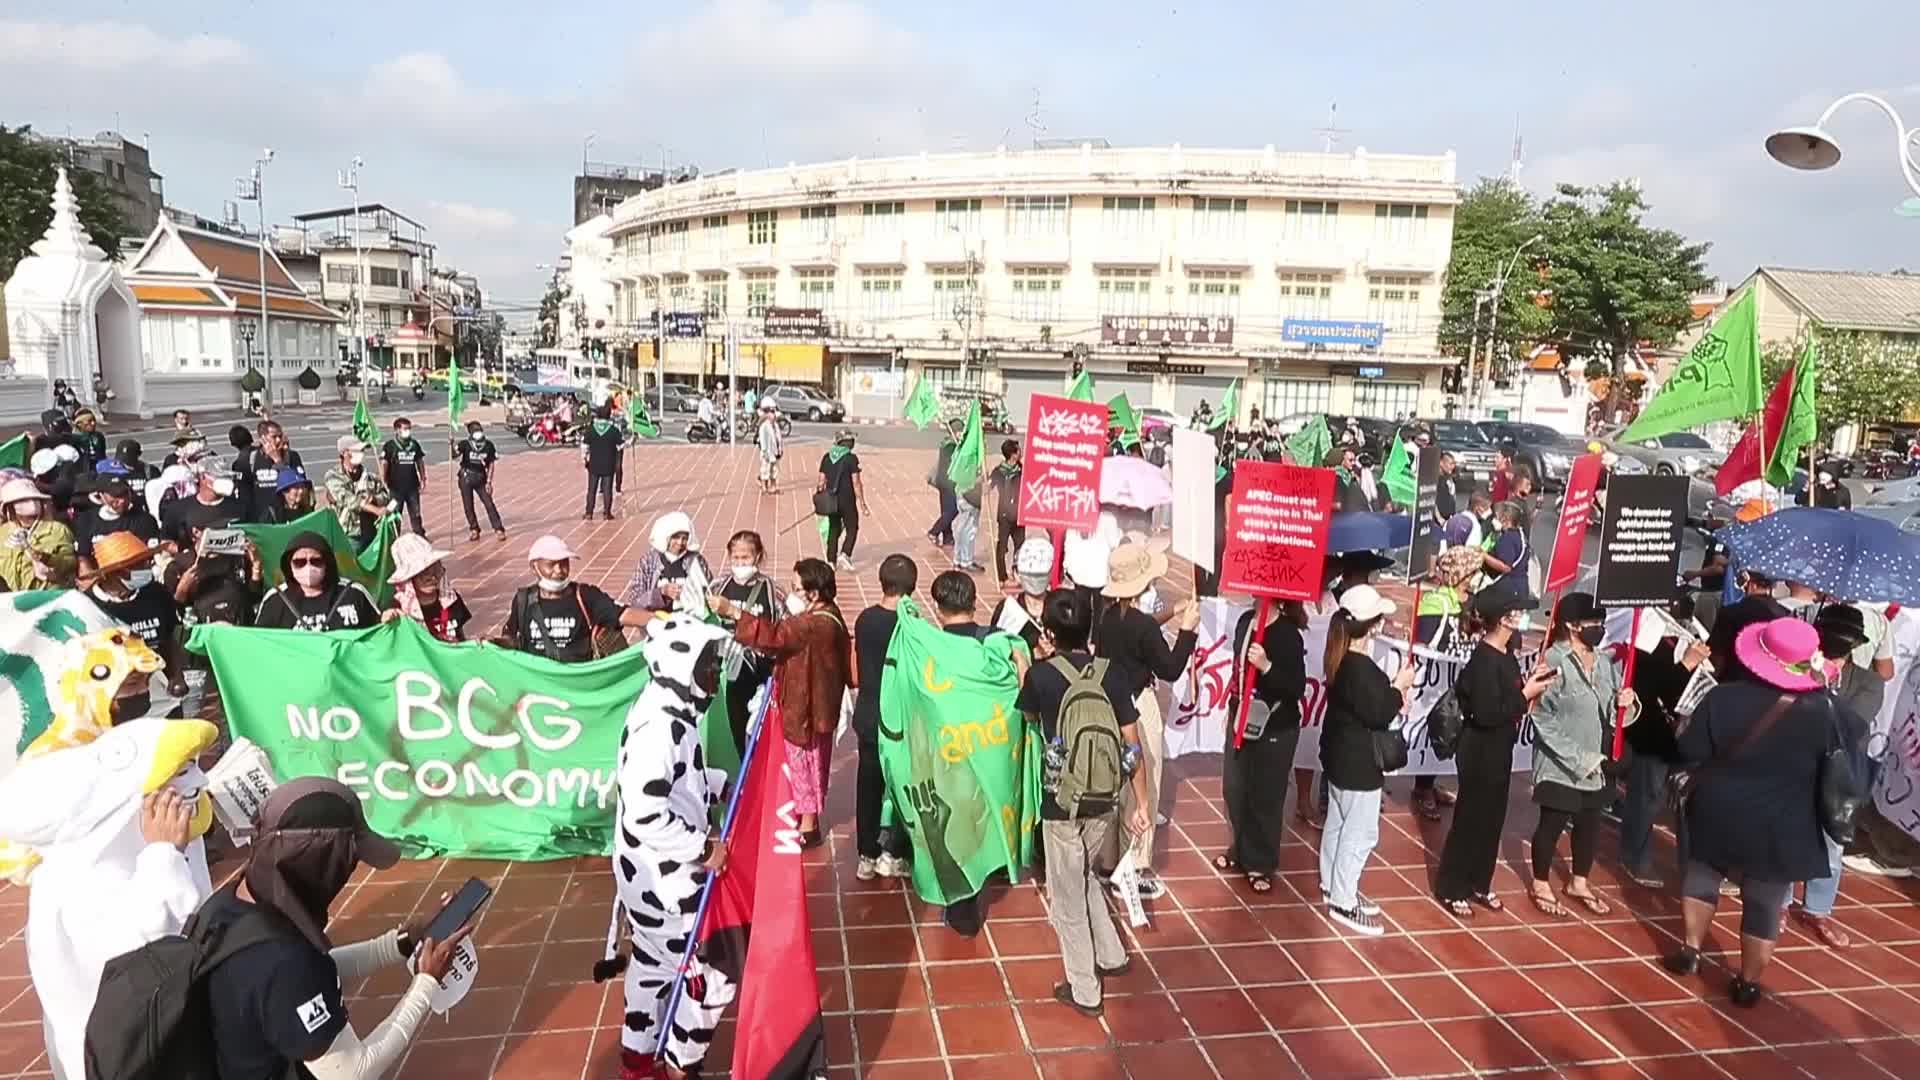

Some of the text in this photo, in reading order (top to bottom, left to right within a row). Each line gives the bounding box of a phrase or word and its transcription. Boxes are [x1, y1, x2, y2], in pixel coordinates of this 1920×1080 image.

[1053, 440, 1076, 454] using
[1077, 442, 1098, 456] APEC
[1034, 452, 1094, 471] white-washing
[1246, 489, 1317, 507] APEC must not
[1236, 503, 1323, 521] participate in Thai
[1633, 507, 1660, 517] demand
[1661, 509, 1672, 517] our
[1244, 518, 1312, 534] state's human
[1616, 518, 1643, 530] rightful
[1236, 530, 1316, 549] rights violations.
[1616, 530, 1671, 541] making power to
[1608, 542, 1676, 552] manage our land and
[1611, 553, 1637, 562] natural
[286, 670, 583, 750] NO BCG
[337, 760, 617, 808] ECONOMY
